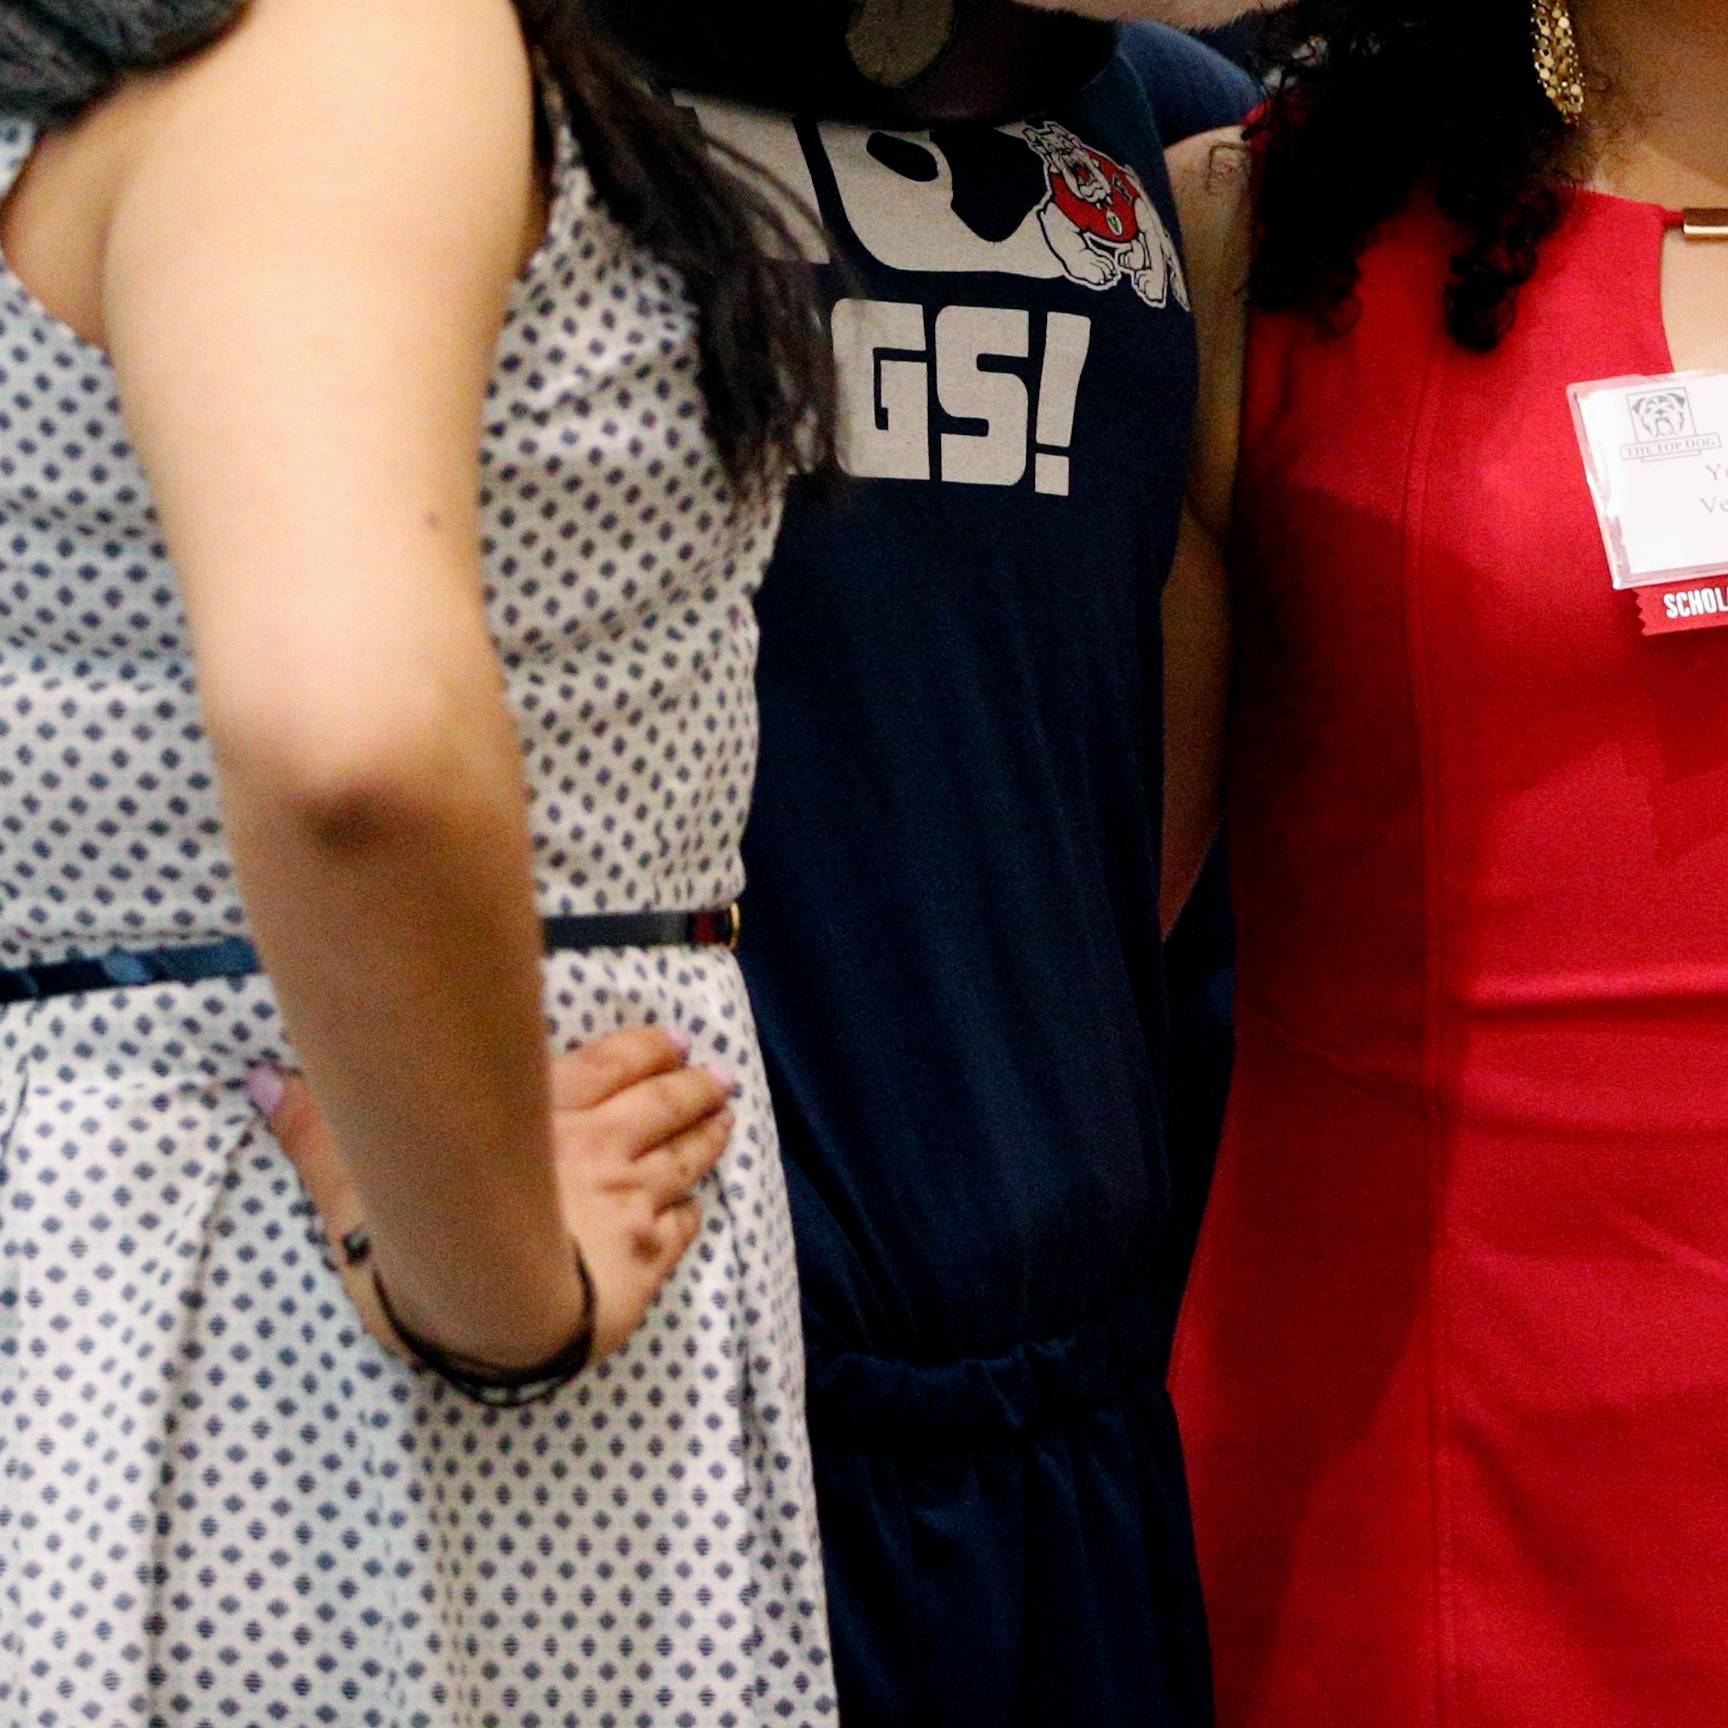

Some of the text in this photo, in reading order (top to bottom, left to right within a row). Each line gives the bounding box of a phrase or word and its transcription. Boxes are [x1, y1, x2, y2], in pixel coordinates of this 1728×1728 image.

[1627, 437, 1716, 457] THE TOP DOG
